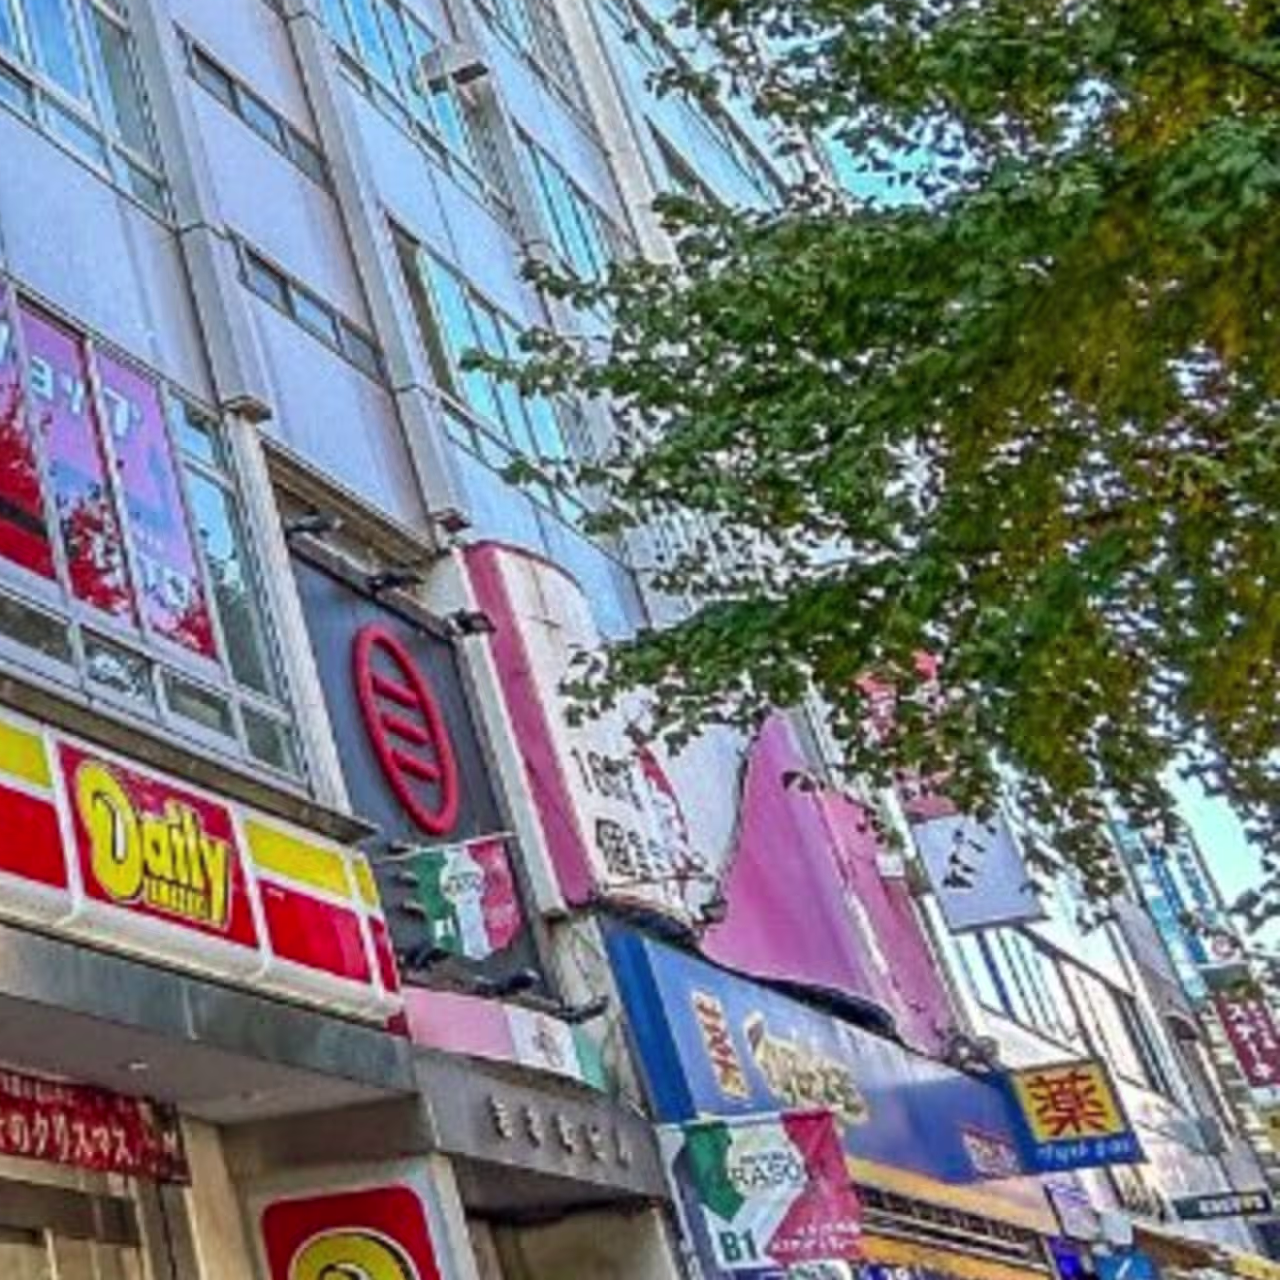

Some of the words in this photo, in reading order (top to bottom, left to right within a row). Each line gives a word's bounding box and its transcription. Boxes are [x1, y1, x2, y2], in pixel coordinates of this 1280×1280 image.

[76, 758, 231, 930] Daily
[1026, 1070, 1112, 1138] 薬
[720, 1228, 758, 1263] B1
